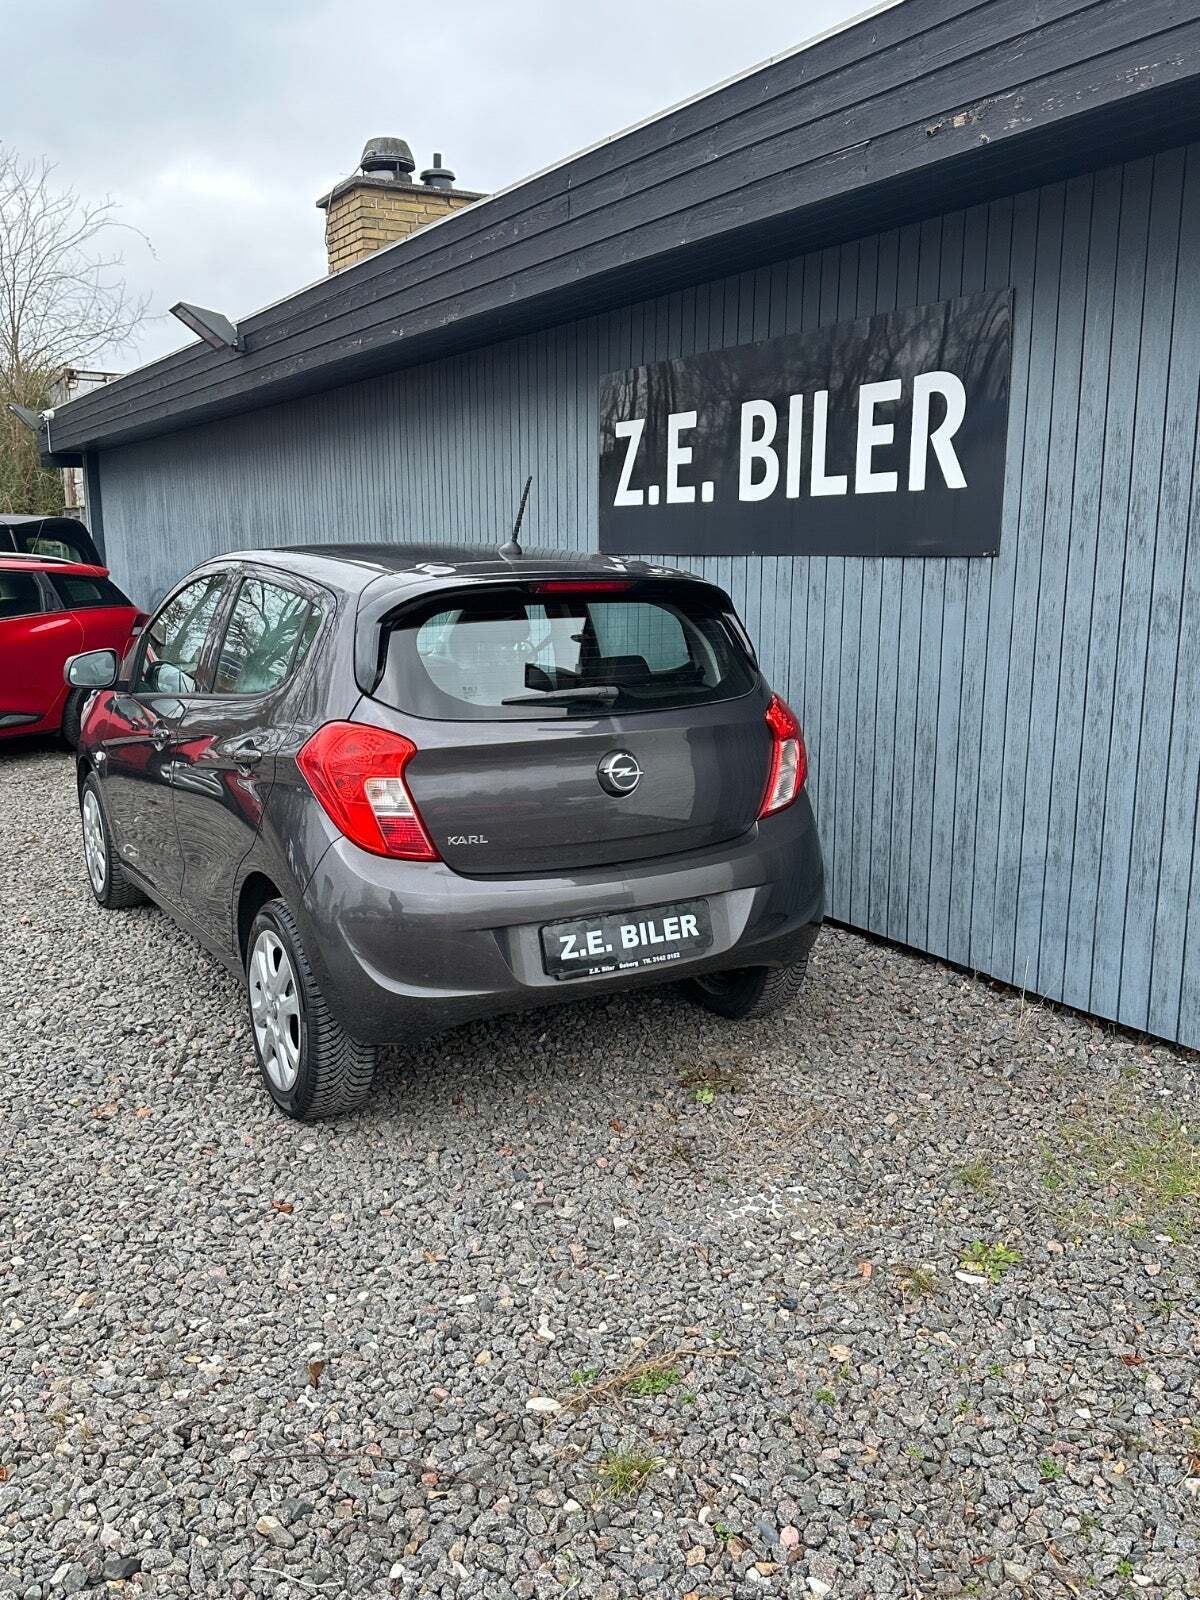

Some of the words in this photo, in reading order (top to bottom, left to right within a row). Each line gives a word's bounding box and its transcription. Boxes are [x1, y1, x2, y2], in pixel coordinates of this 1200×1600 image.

[613, 410, 715, 507] Z.E.
[738, 370, 968, 502] BILER
[447, 834, 489, 846] KARL
[559, 930, 613, 960] Z.E.
[620, 914, 699, 949] BILER
[601, 965, 616, 973] Biler
